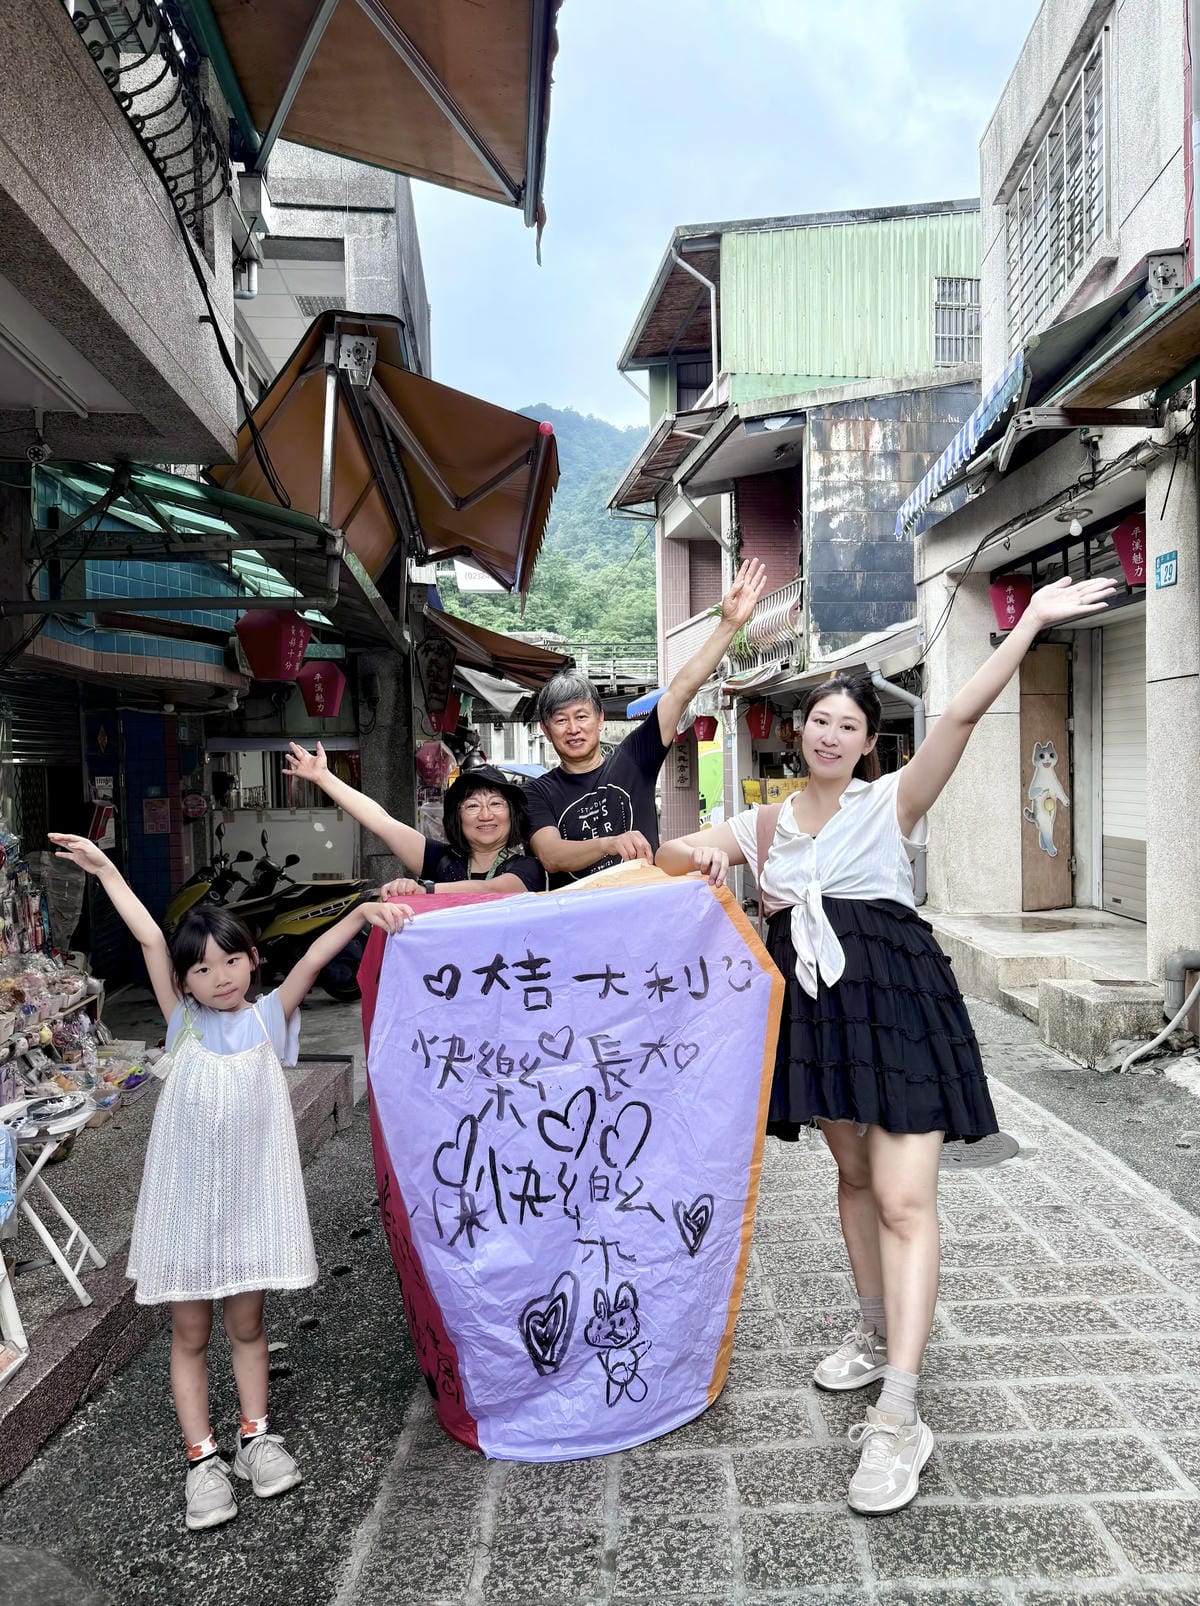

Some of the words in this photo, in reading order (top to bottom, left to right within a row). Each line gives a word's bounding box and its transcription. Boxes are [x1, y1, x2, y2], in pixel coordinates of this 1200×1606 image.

[1130, 527, 1144, 577] 平溪魅力
[1163, 563, 1173, 582] 29
[1004, 584, 1017, 624] 平溪魅力
